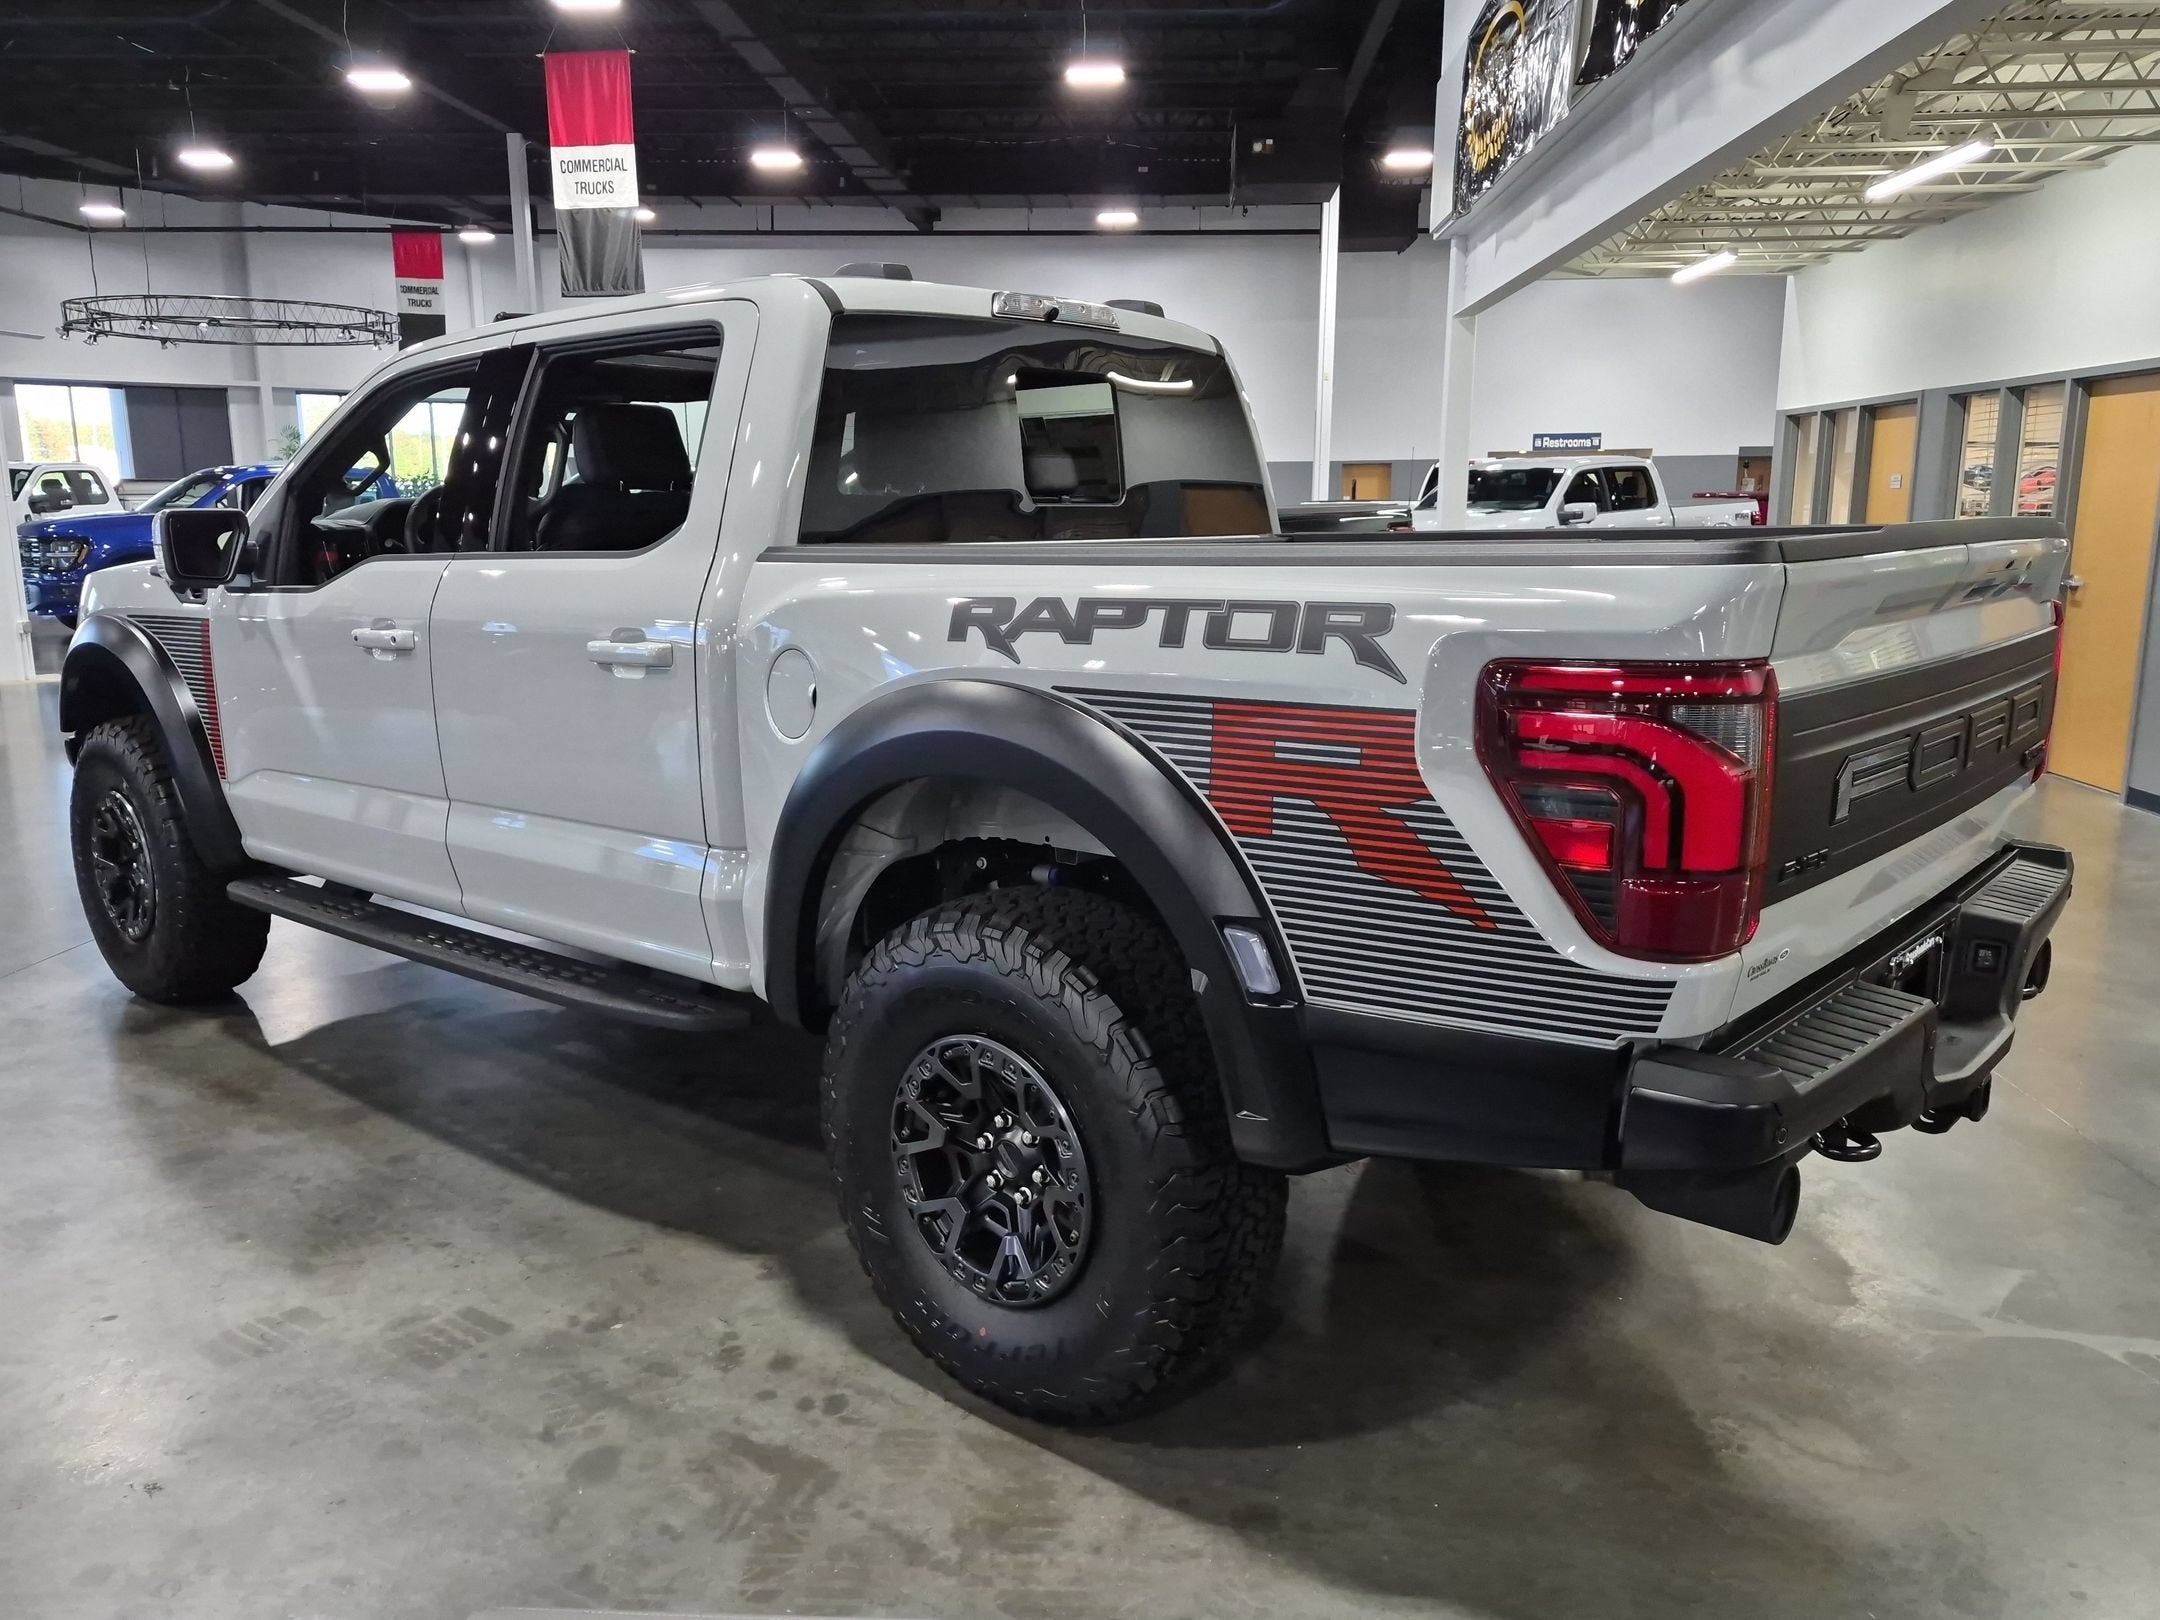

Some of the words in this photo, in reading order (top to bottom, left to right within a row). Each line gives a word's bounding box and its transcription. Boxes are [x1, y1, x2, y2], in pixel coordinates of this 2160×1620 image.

[560, 158, 627, 173] COMMERCIAL
[575, 180, 614, 194] TRUCKS
[408, 298, 432, 307] TRUCKS
[1542, 436, 1592, 448] Restrooms
[947, 596, 1408, 685] RAPTOR
[1829, 682, 2043, 828] FORD
